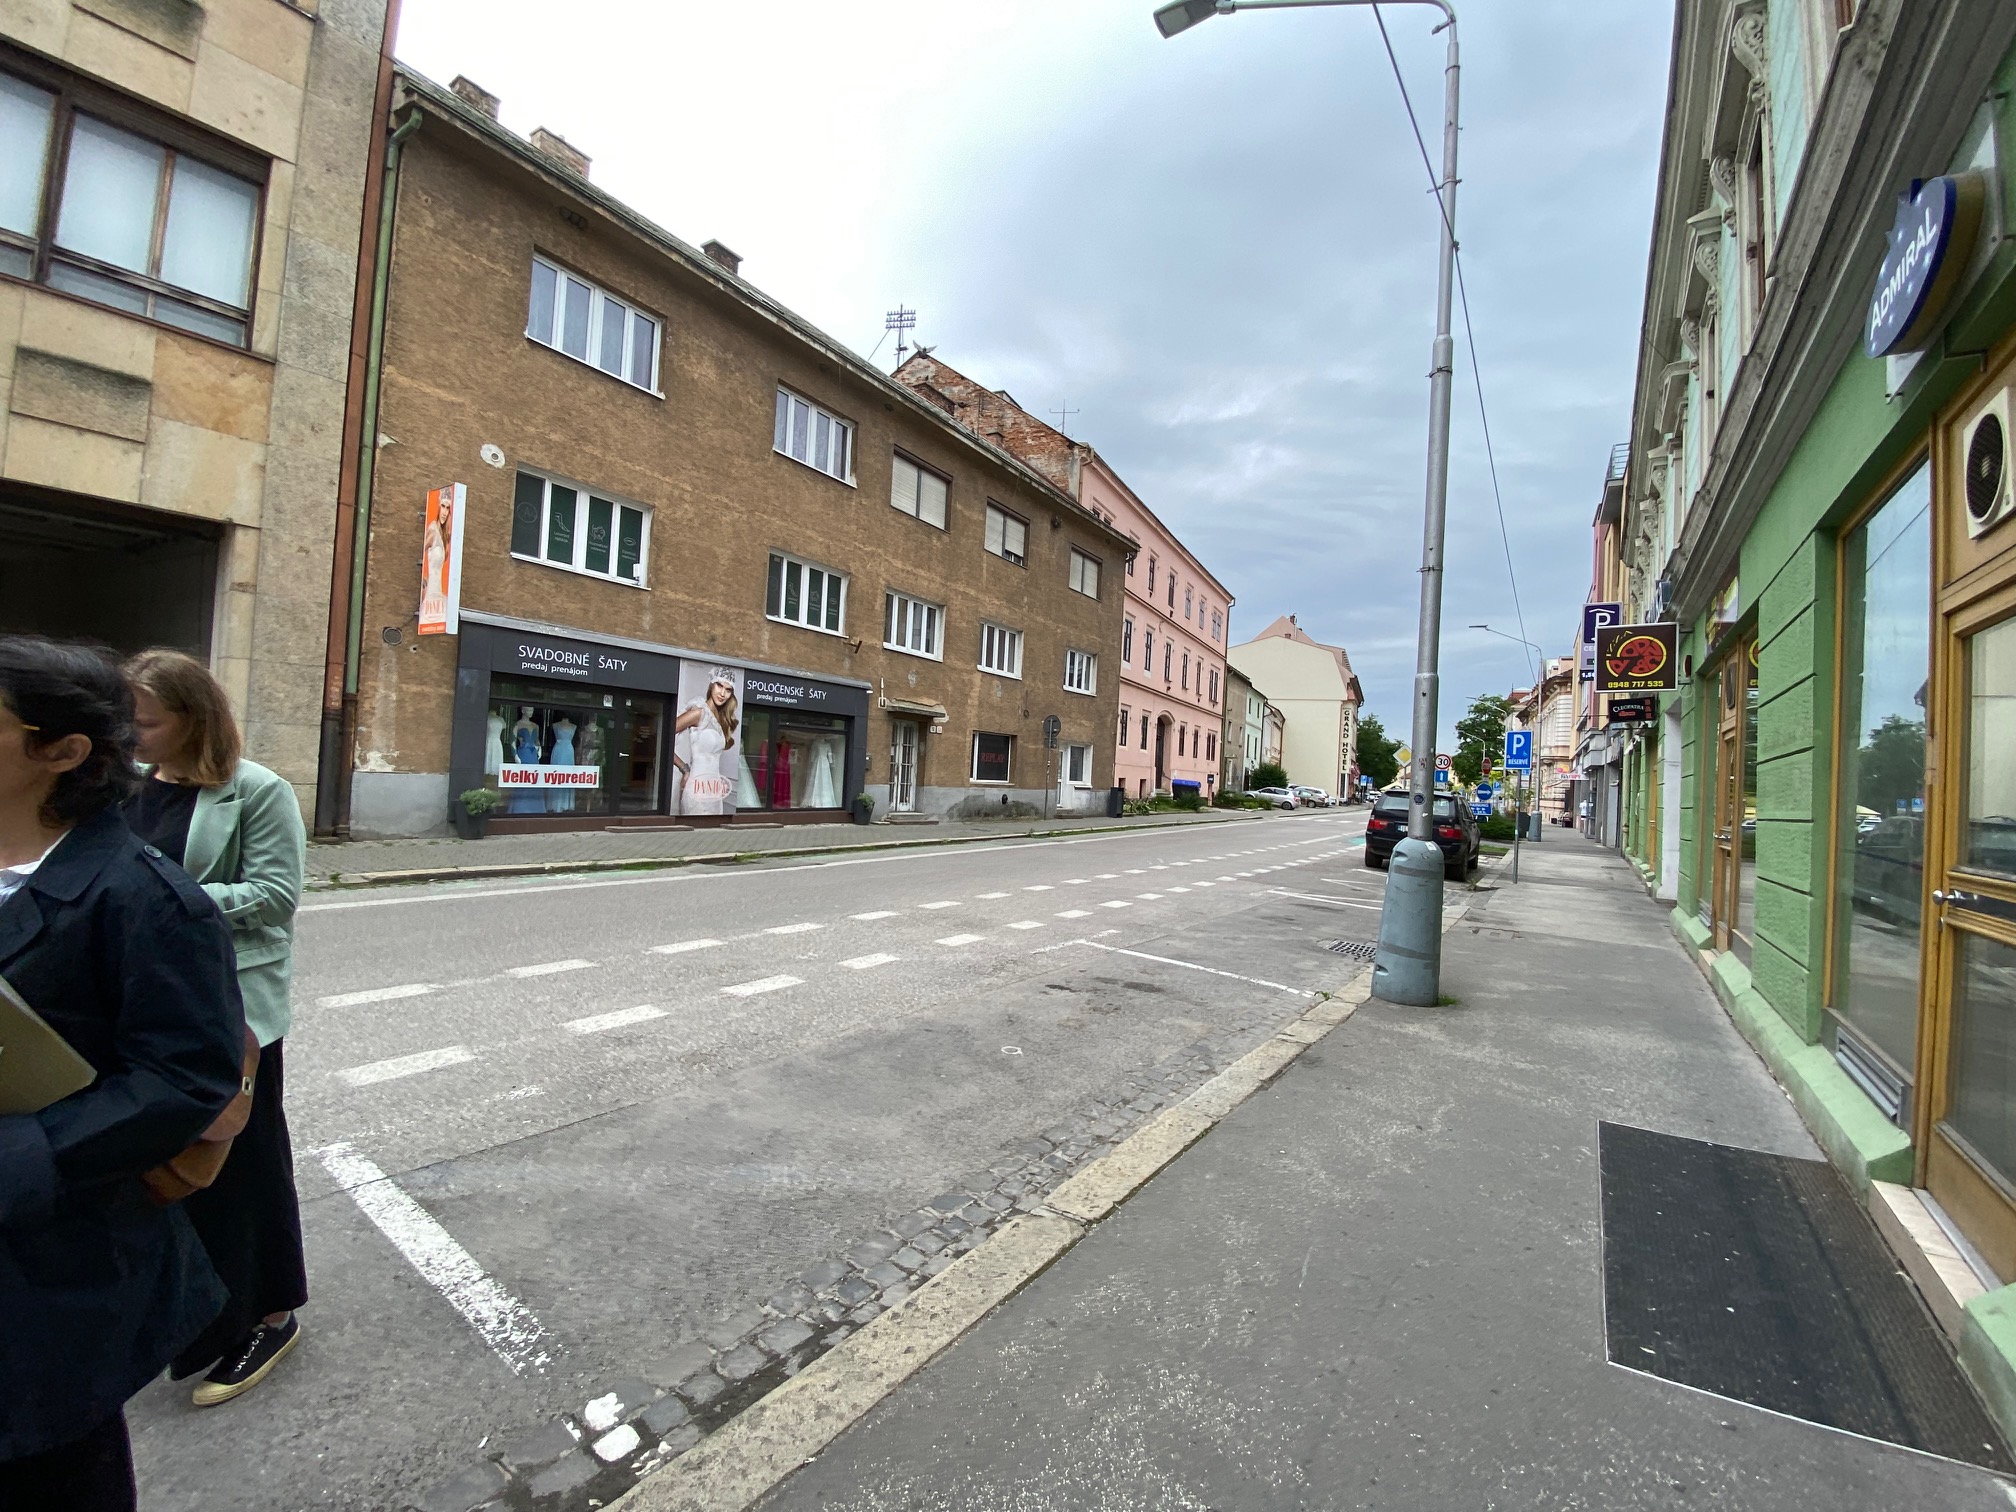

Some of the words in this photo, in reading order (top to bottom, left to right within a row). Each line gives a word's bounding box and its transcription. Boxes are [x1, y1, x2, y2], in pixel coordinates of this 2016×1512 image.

[1869, 207, 1938, 340] ADMIRAL
[518, 644, 590, 667] SVADOBNÉ
[598, 655, 628, 671] ŠATY
[521, 661, 548, 672] predaj
[551, 664, 588, 676] prenájom
[746, 680, 804, 697] SPOLOČENSKÉ
[808, 688, 827, 700] ŠATY
[756, 693, 773, 702] predaj
[1612, 704, 1644, 713] CLEOPATRA
[1512, 734, 1525, 755] P
[1437, 757, 1449, 766] 30
[544, 770, 598, 785] výpredaj
